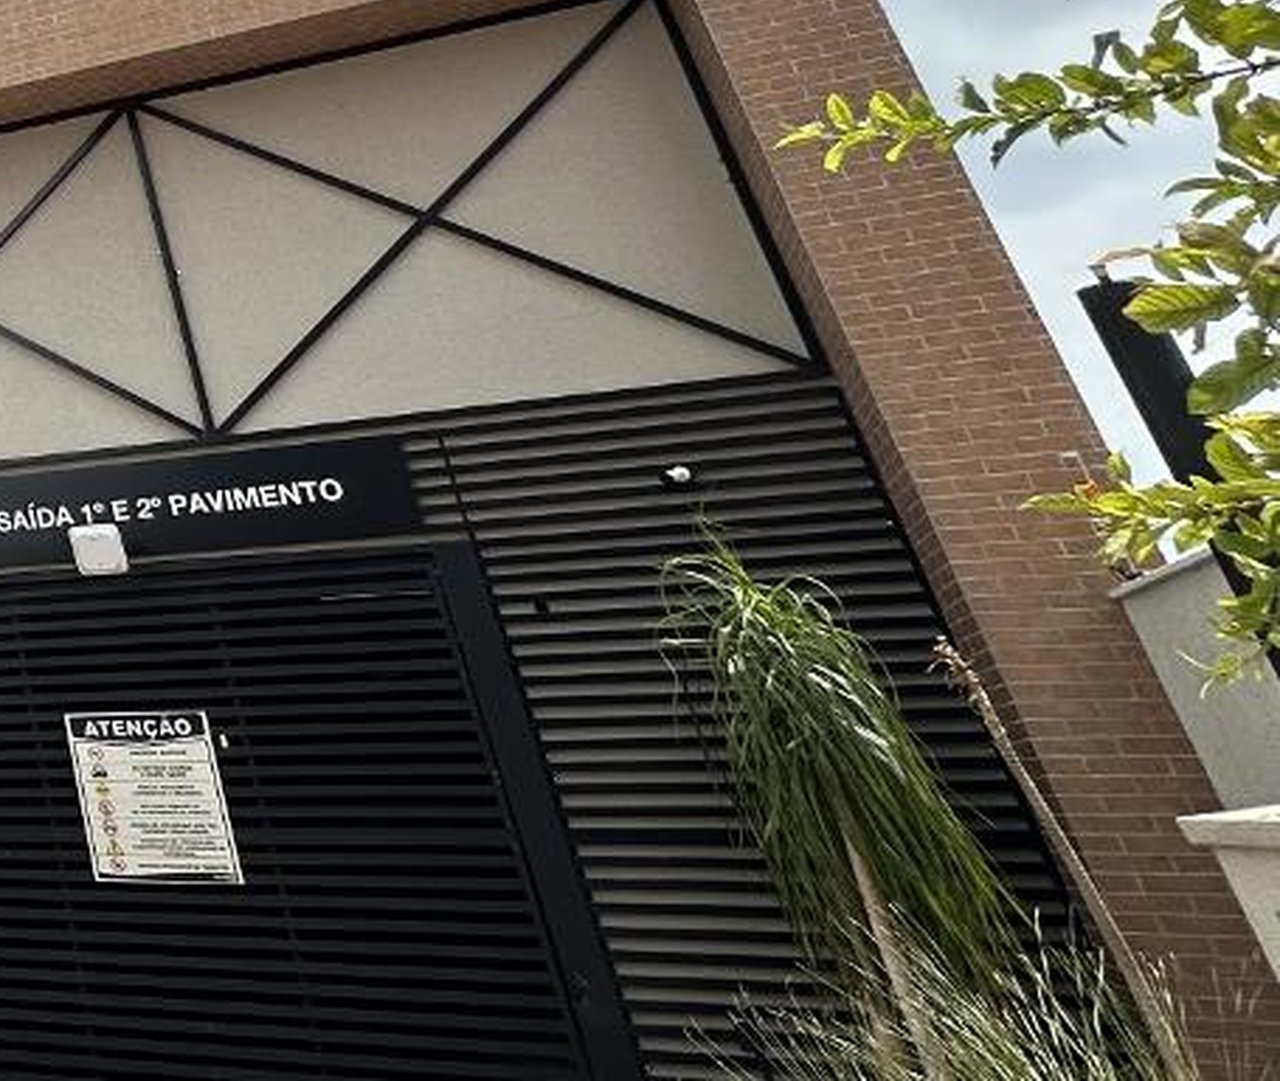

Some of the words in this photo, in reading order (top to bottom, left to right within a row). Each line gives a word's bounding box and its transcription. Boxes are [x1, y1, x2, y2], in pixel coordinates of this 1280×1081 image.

[110, 499, 131, 522] E
[136, 496, 162, 520] 2º
[168, 478, 344, 517] PAVIMENTO
